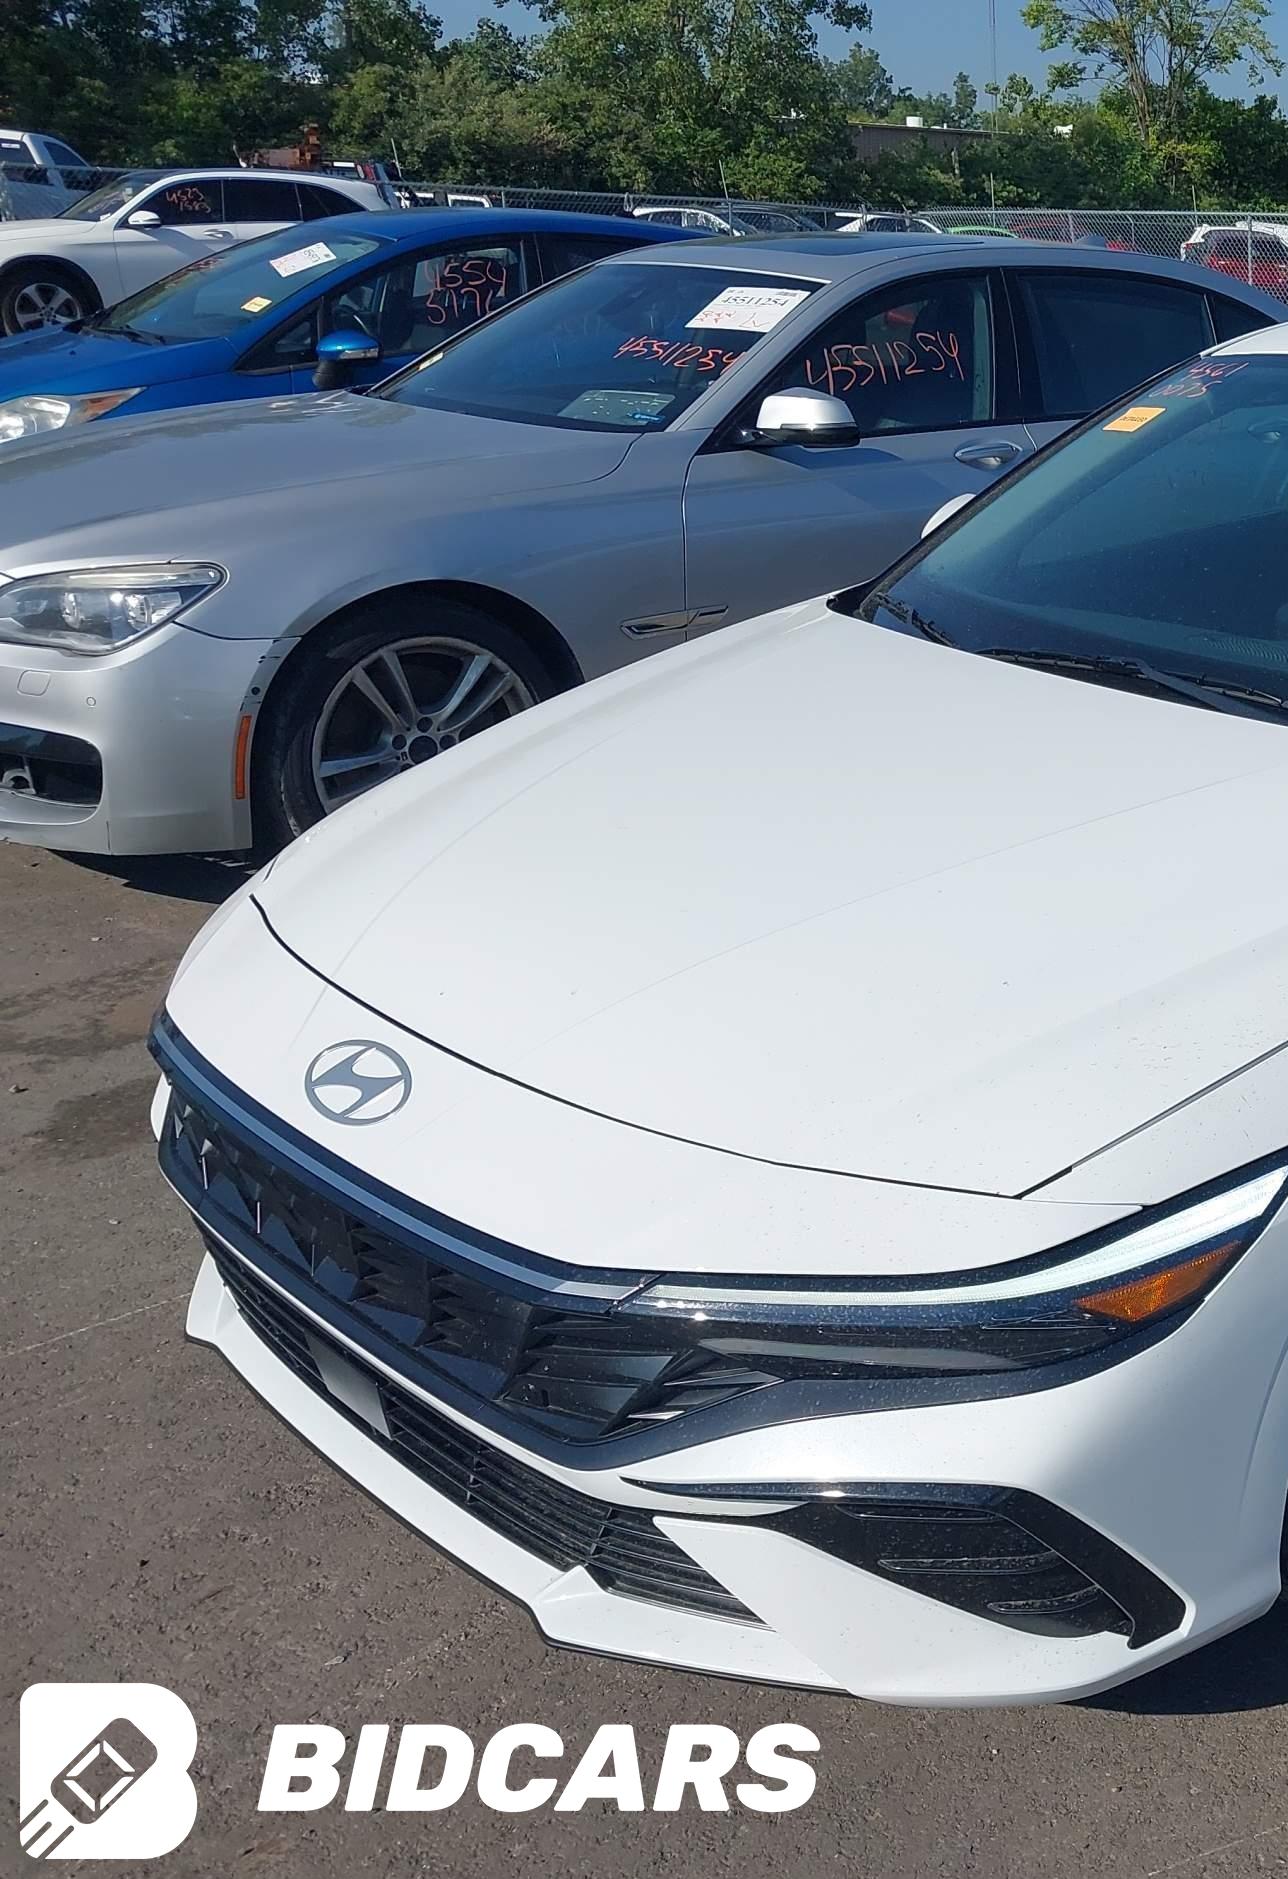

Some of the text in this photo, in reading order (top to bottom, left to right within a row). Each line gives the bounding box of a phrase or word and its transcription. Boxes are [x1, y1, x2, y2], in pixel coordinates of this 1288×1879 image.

[424, 260, 507, 295] 4554
[721, 295, 789, 307] 45511254
[613, 335, 748, 374] 45511254
[806, 330, 965, 396] 45511254
[1179, 361, 1250, 384] 4561
